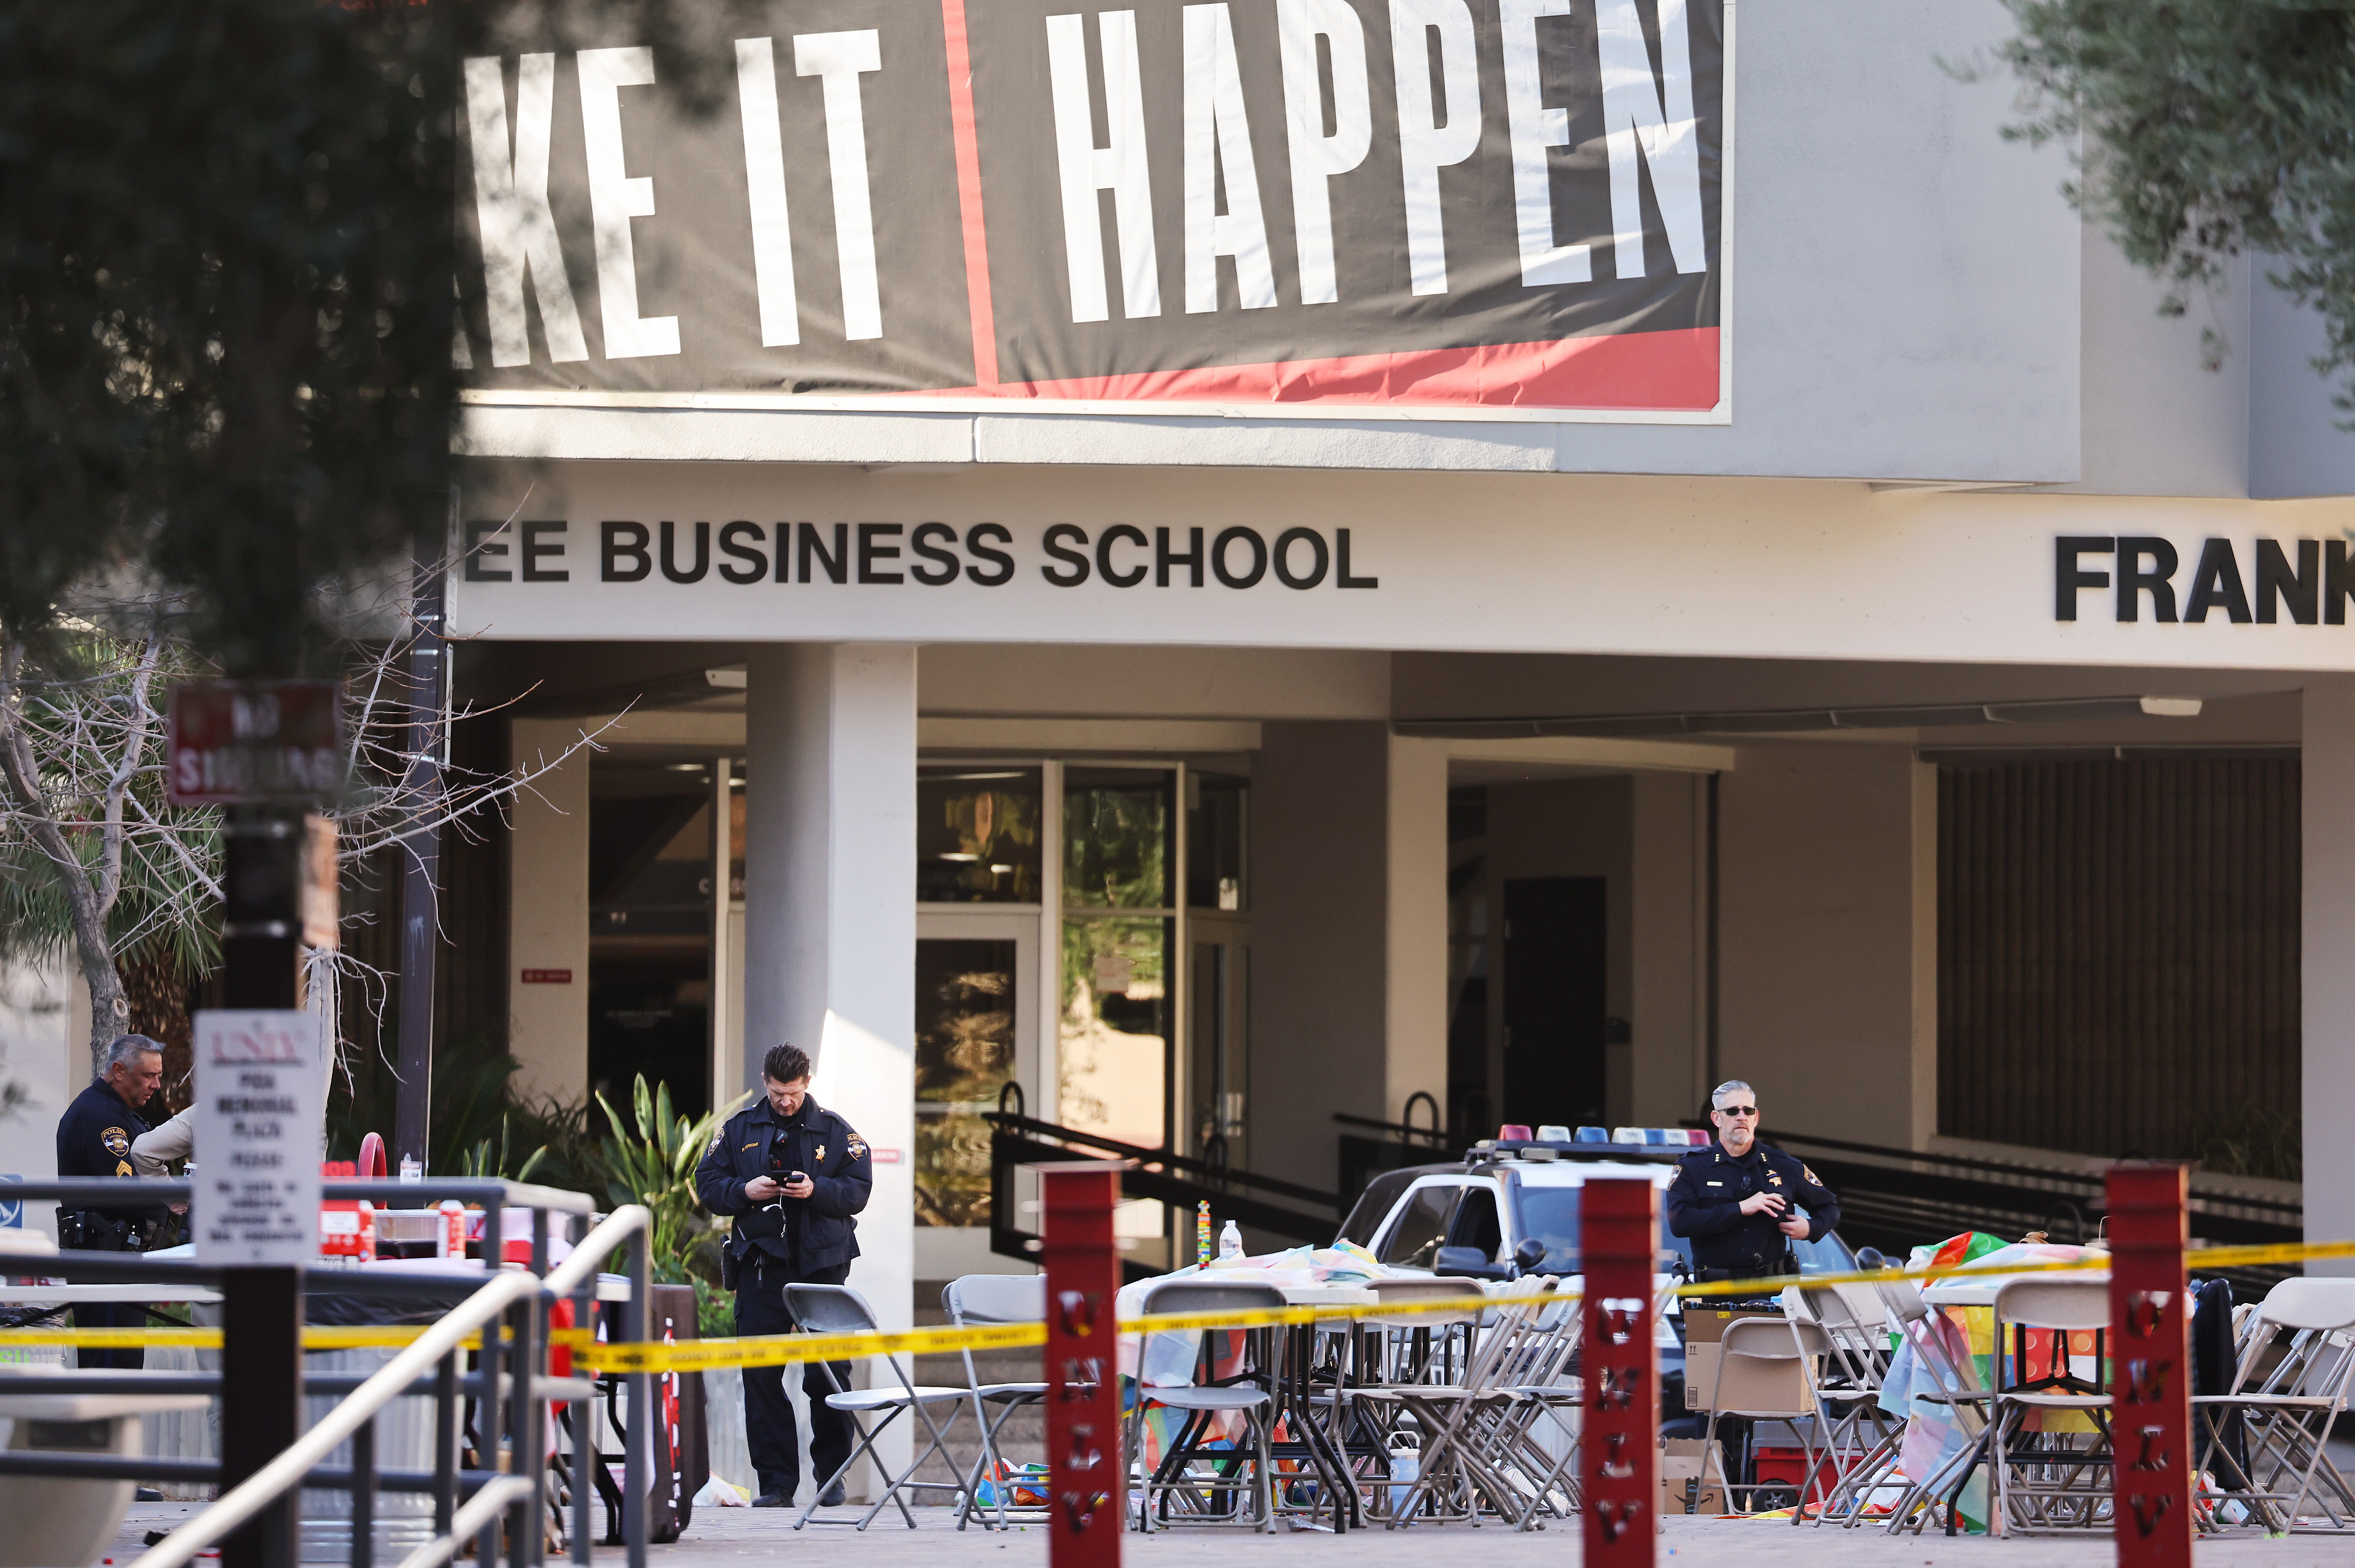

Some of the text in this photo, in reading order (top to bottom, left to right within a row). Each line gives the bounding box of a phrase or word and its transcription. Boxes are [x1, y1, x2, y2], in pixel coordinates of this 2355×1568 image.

[452, 0, 1707, 370] KE IT HAPPEN
[601, 520, 1015, 586] BUSINESS
[1041, 523, 1378, 589] SCHOOL
